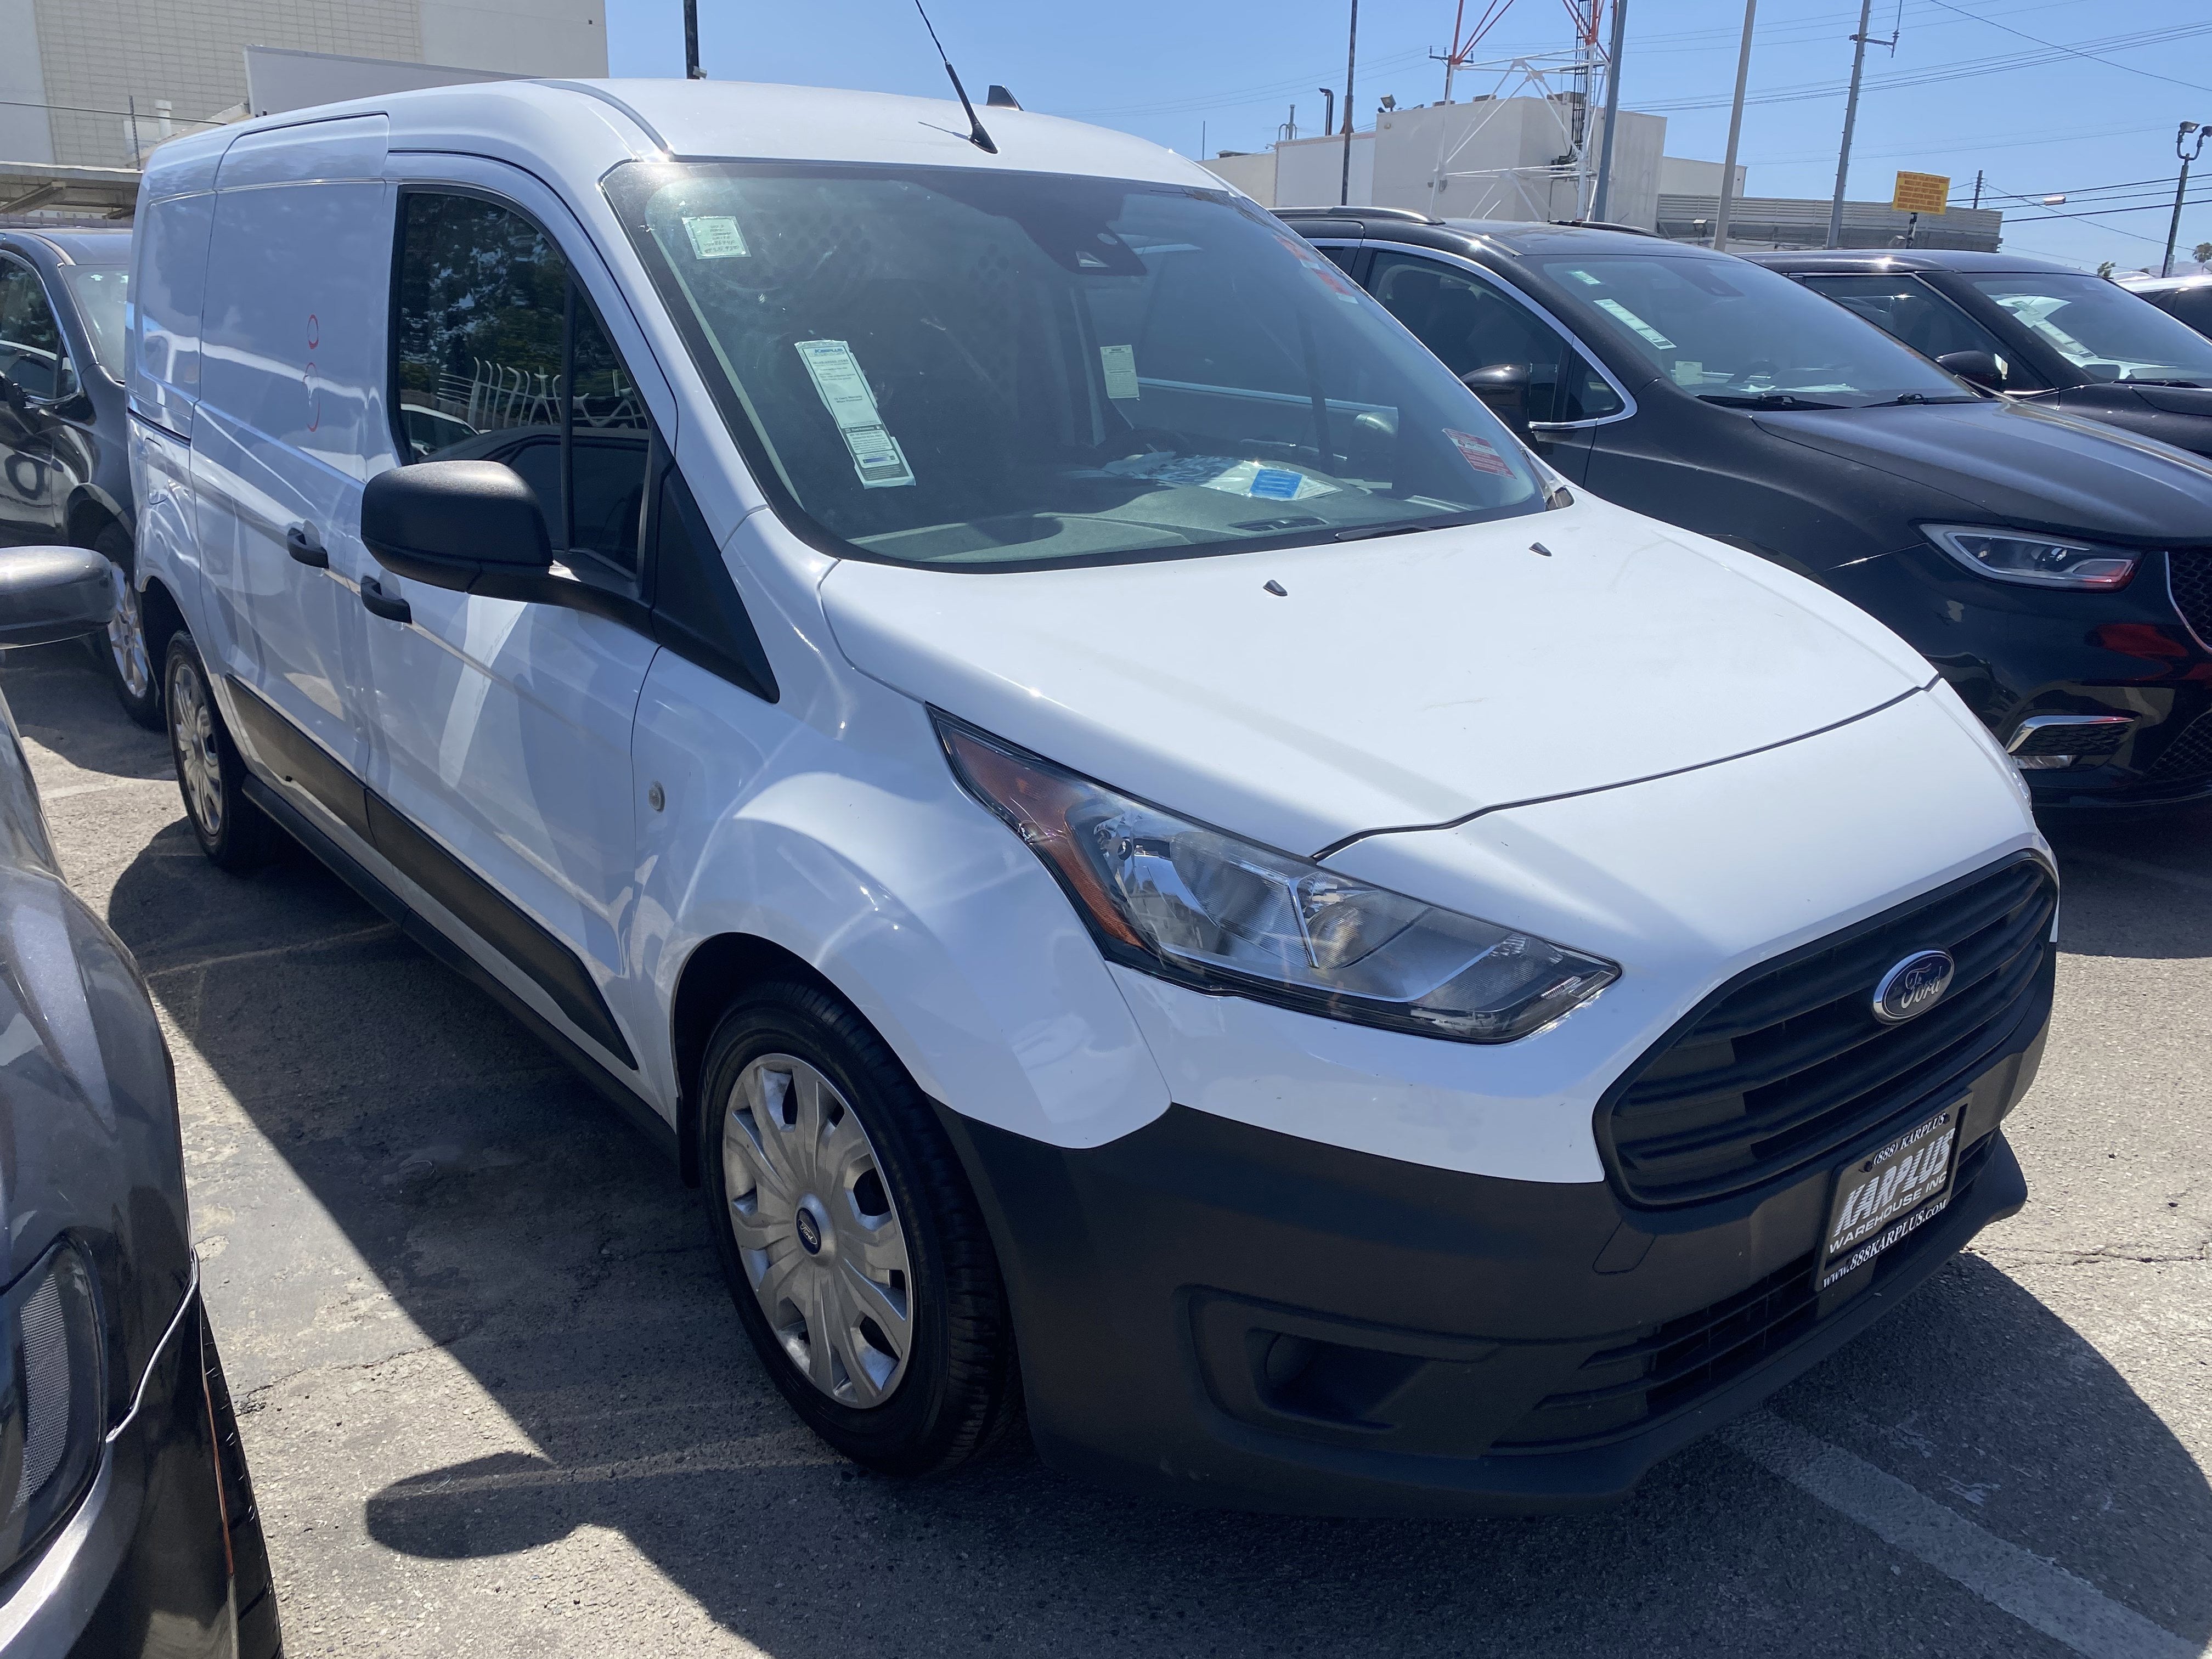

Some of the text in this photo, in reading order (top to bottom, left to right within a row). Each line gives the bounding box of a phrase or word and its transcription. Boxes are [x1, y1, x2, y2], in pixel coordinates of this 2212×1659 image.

[1901, 963, 1943, 1008] Ford
[1874, 1113, 1946, 1165] (888) KARPLUS
[1832, 1127, 1955, 1237] KARPLUS
[800, 1223, 814, 1241] Ford
[1830, 1188, 1922, 1254] WAREHOUSE
